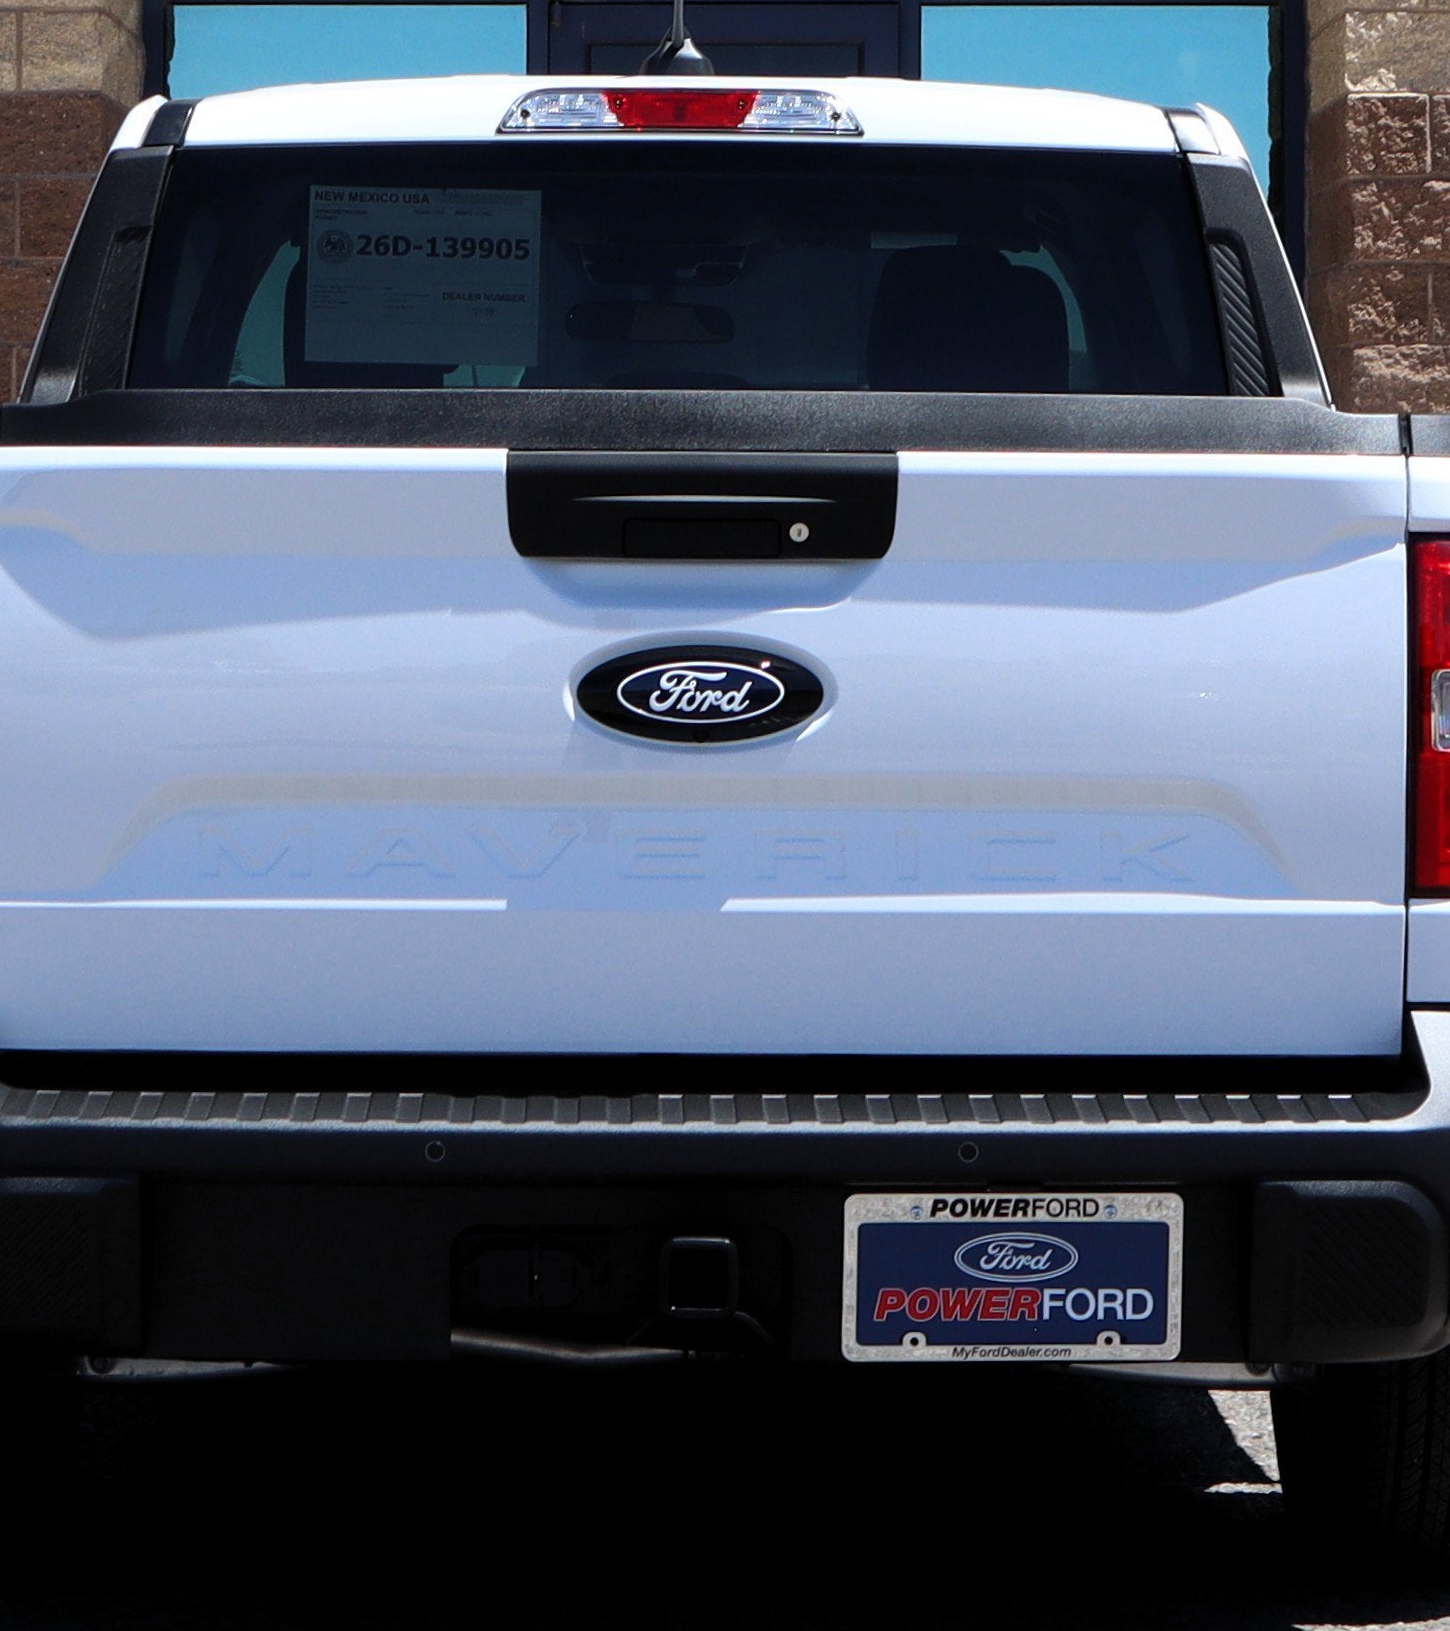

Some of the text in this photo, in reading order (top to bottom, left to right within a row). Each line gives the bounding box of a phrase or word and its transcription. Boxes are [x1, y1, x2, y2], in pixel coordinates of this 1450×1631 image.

[314, 190, 344, 202] NEW
[348, 191, 399, 203] MEXICO
[402, 193, 430, 205] USA
[355, 233, 531, 260] 26D-139905
[442, 291, 525, 303] DEALER NUMBER
[647, 665, 750, 716] Ford
[196, 823, 1196, 885] MAVERICK
[929, 1197, 1100, 1219] POWERFORD
[979, 1241, 1052, 1271] Ford
[874, 1287, 1154, 1321] POWERFORD
[951, 1345, 1072, 1361] MyFordDealer.com
